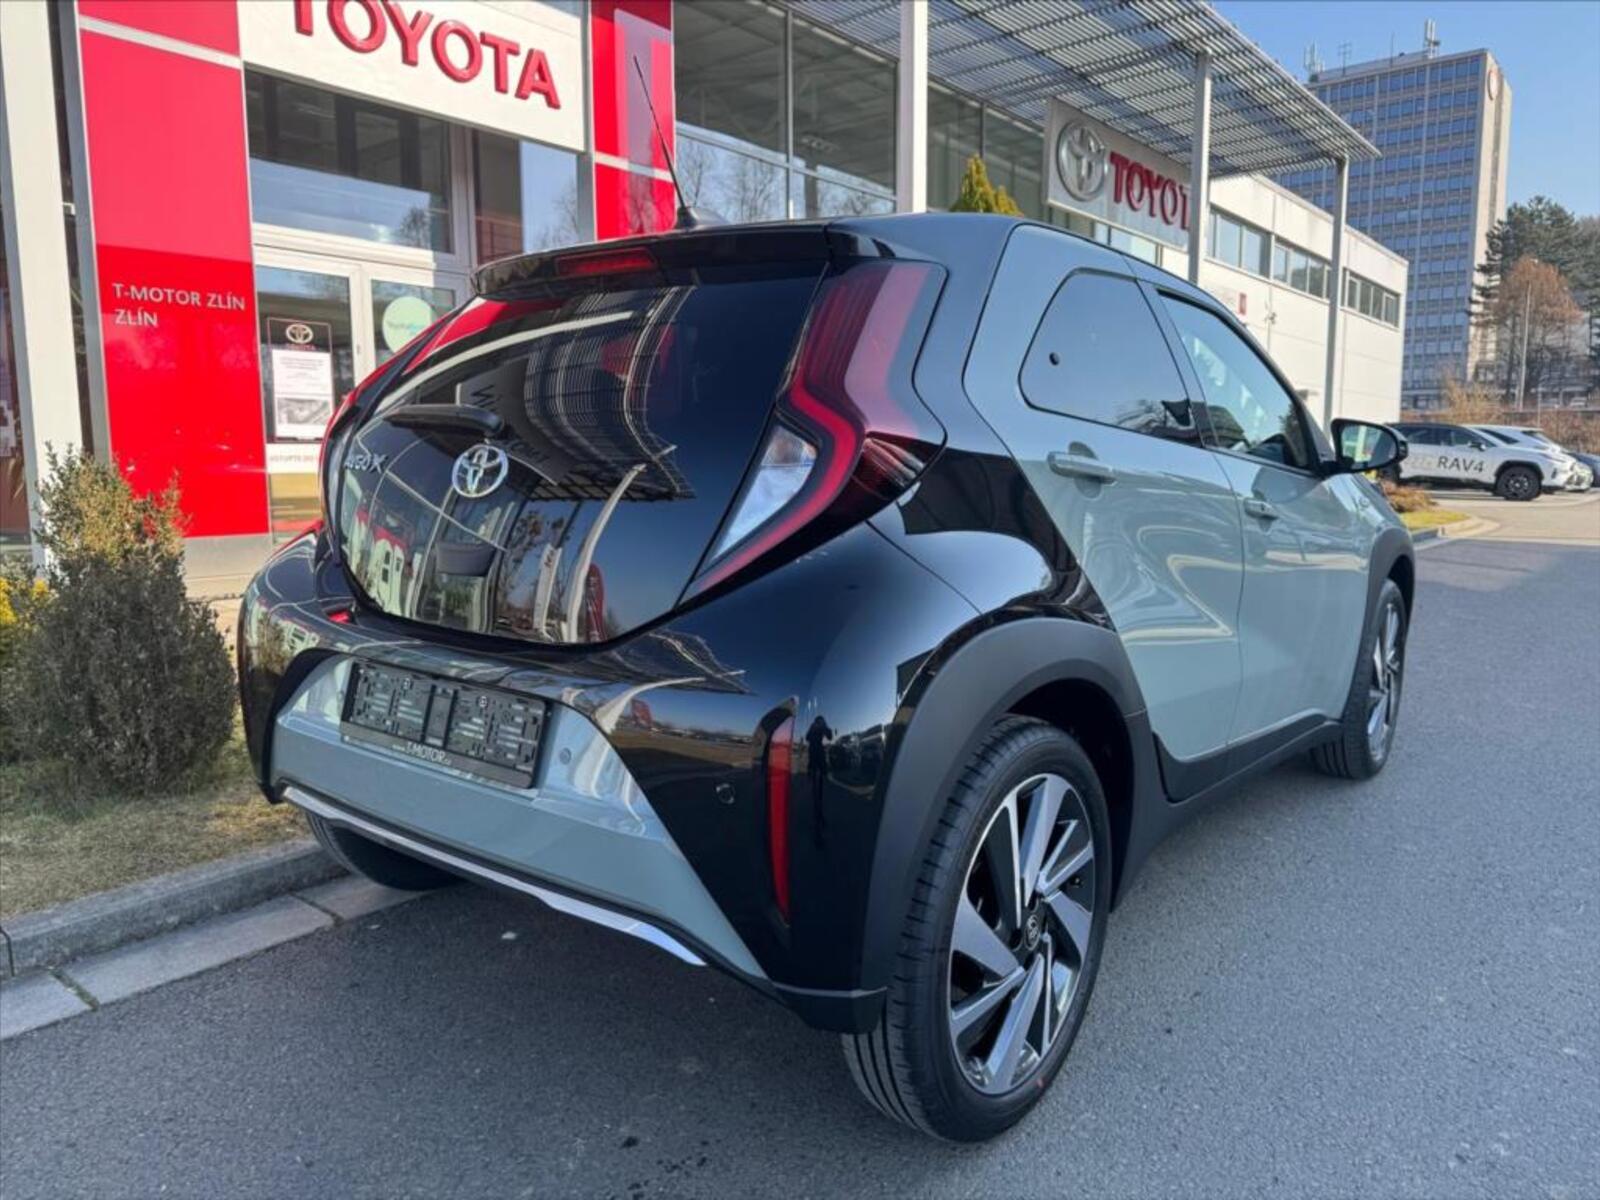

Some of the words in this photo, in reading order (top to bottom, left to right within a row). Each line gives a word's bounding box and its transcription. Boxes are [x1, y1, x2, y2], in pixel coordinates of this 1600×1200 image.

[1110, 151, 1190, 231] TOYOT
[112, 282, 201, 306] T-MOTOR
[206, 291, 246, 311] ZLÍN
[114, 306, 159, 328] ZLÍN
[1436, 455, 1486, 473] RAV4
